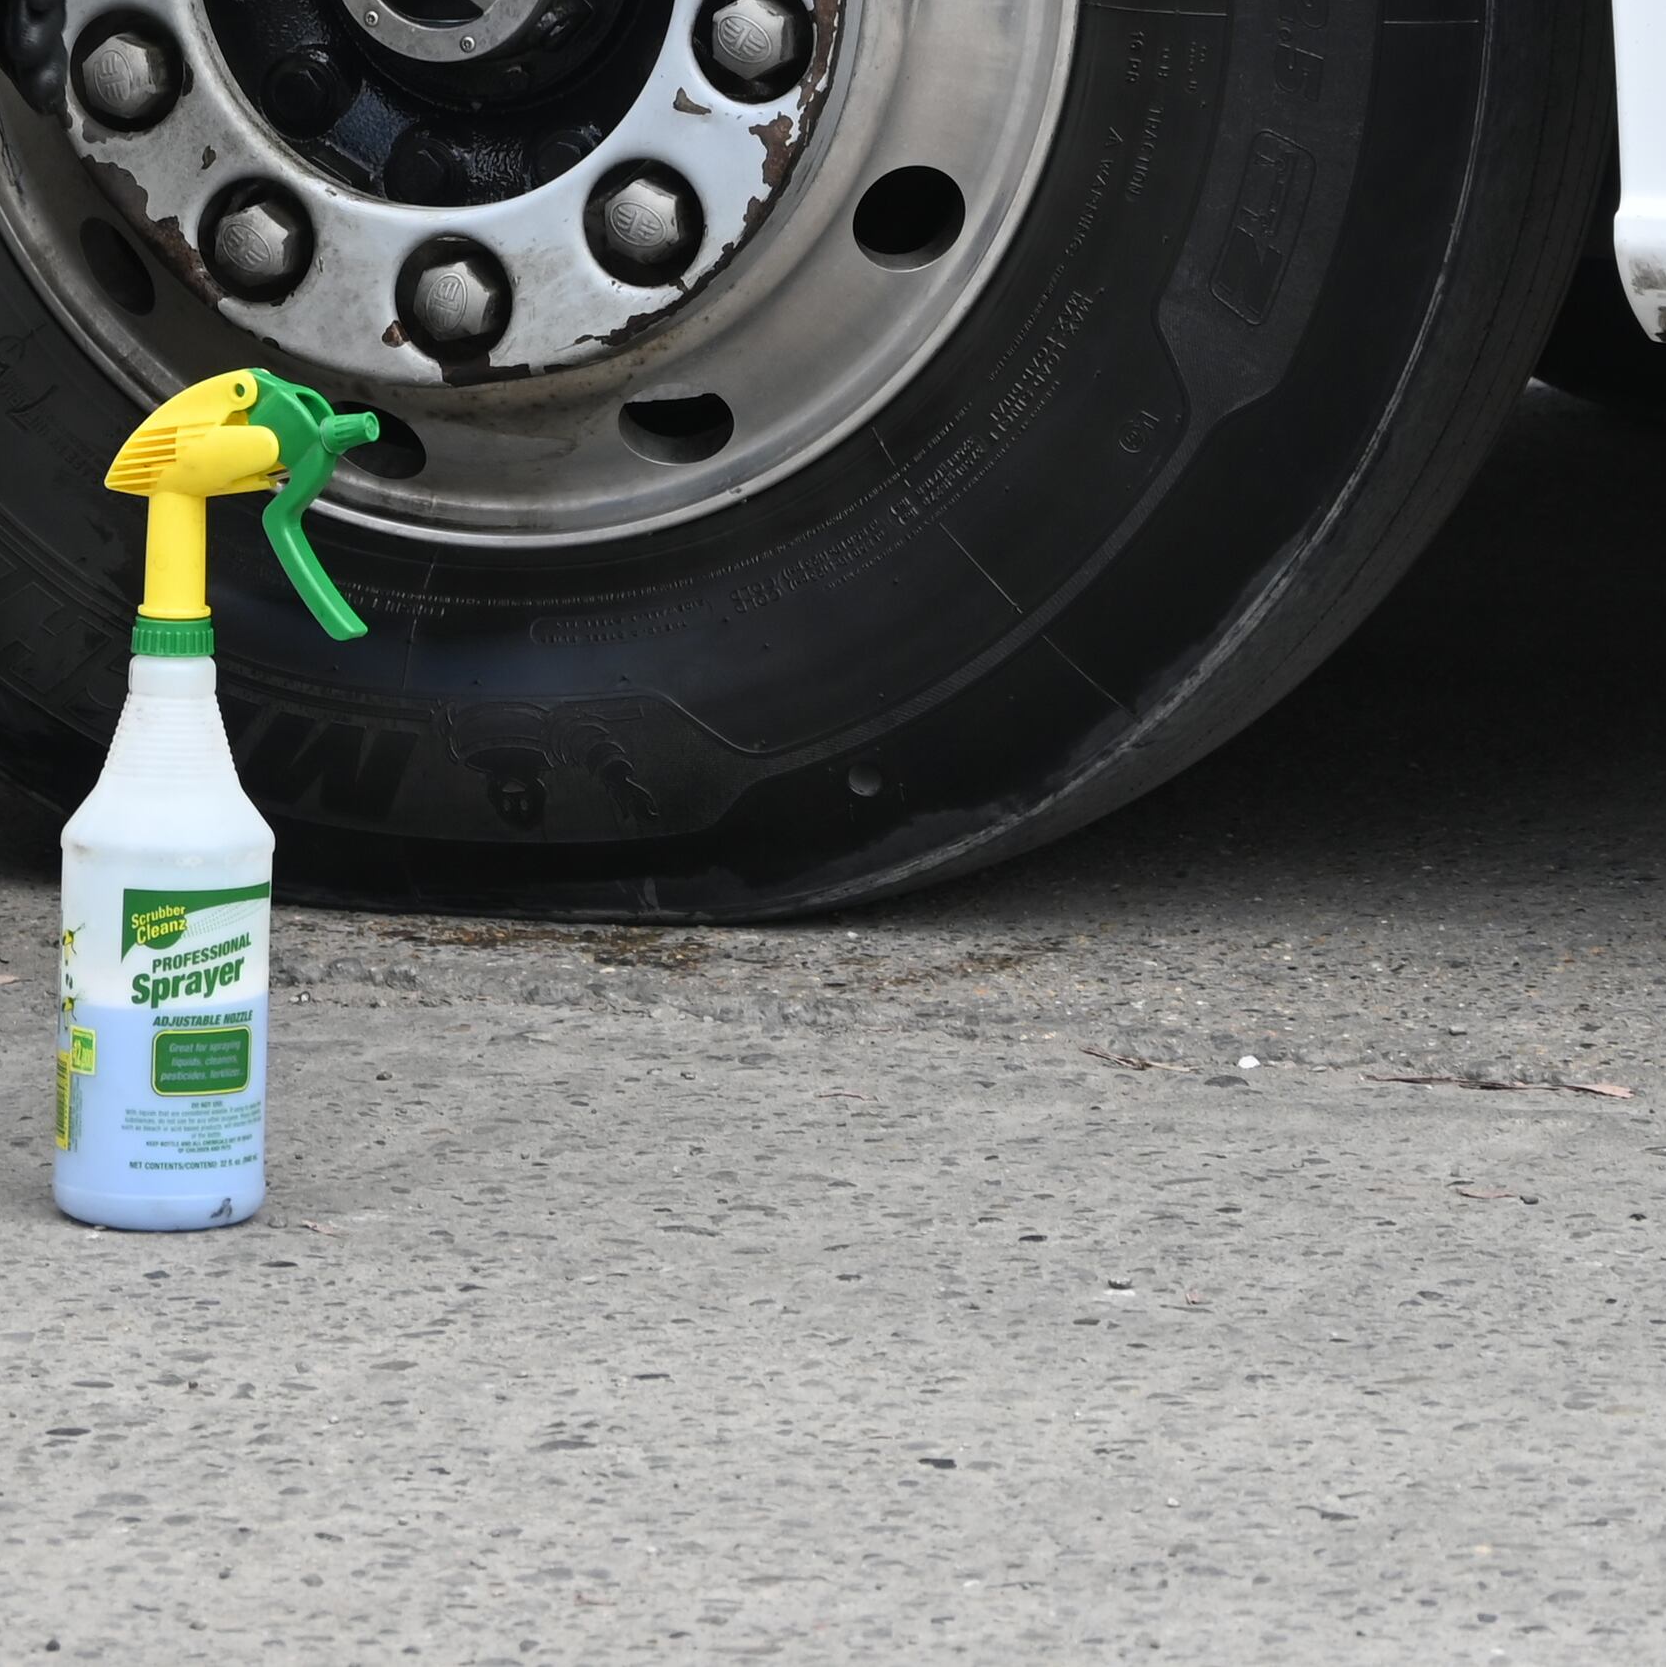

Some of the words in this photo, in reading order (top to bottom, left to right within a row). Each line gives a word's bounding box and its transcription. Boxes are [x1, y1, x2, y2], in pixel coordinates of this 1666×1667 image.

[131, 905, 186, 929] Scrubber
[136, 918, 187, 945] Cleanz
[152, 931, 252, 974] PROFESSIONAL
[131, 956, 245, 1009] Sprayer
[152, 1014, 222, 1027] ADJUSTABLE
[223, 1009, 253, 1026] NOZZLE
